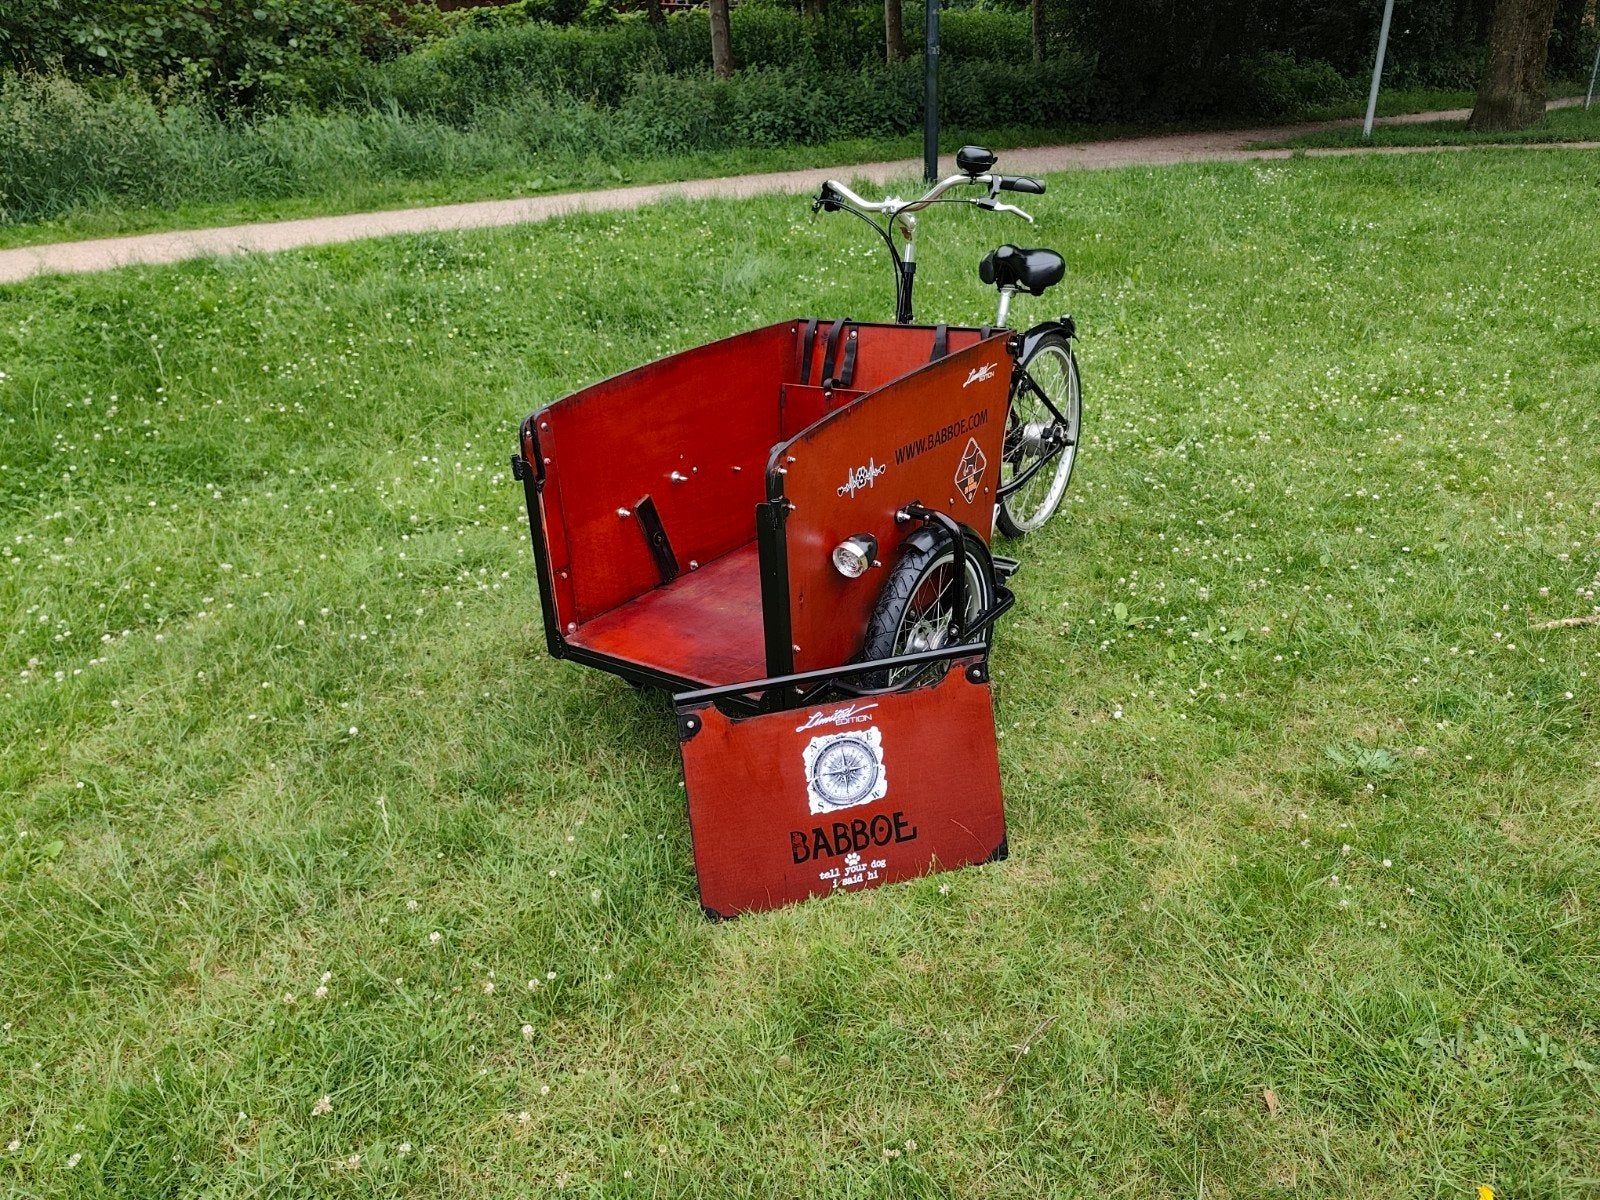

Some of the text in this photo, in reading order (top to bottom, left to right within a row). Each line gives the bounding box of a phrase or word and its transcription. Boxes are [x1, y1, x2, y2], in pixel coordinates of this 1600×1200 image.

[895, 409, 988, 465] WWW.BABBOE.COM
[795, 704, 879, 733] Limited
[835, 714, 873, 726] EDITION
[866, 732, 873, 741] E
[871, 790, 881, 799] W
[817, 801, 825, 811] S
[790, 811, 918, 864] BABBOE
[819, 859, 887, 880] tell your dog
[832, 869, 879, 888] i said hi
